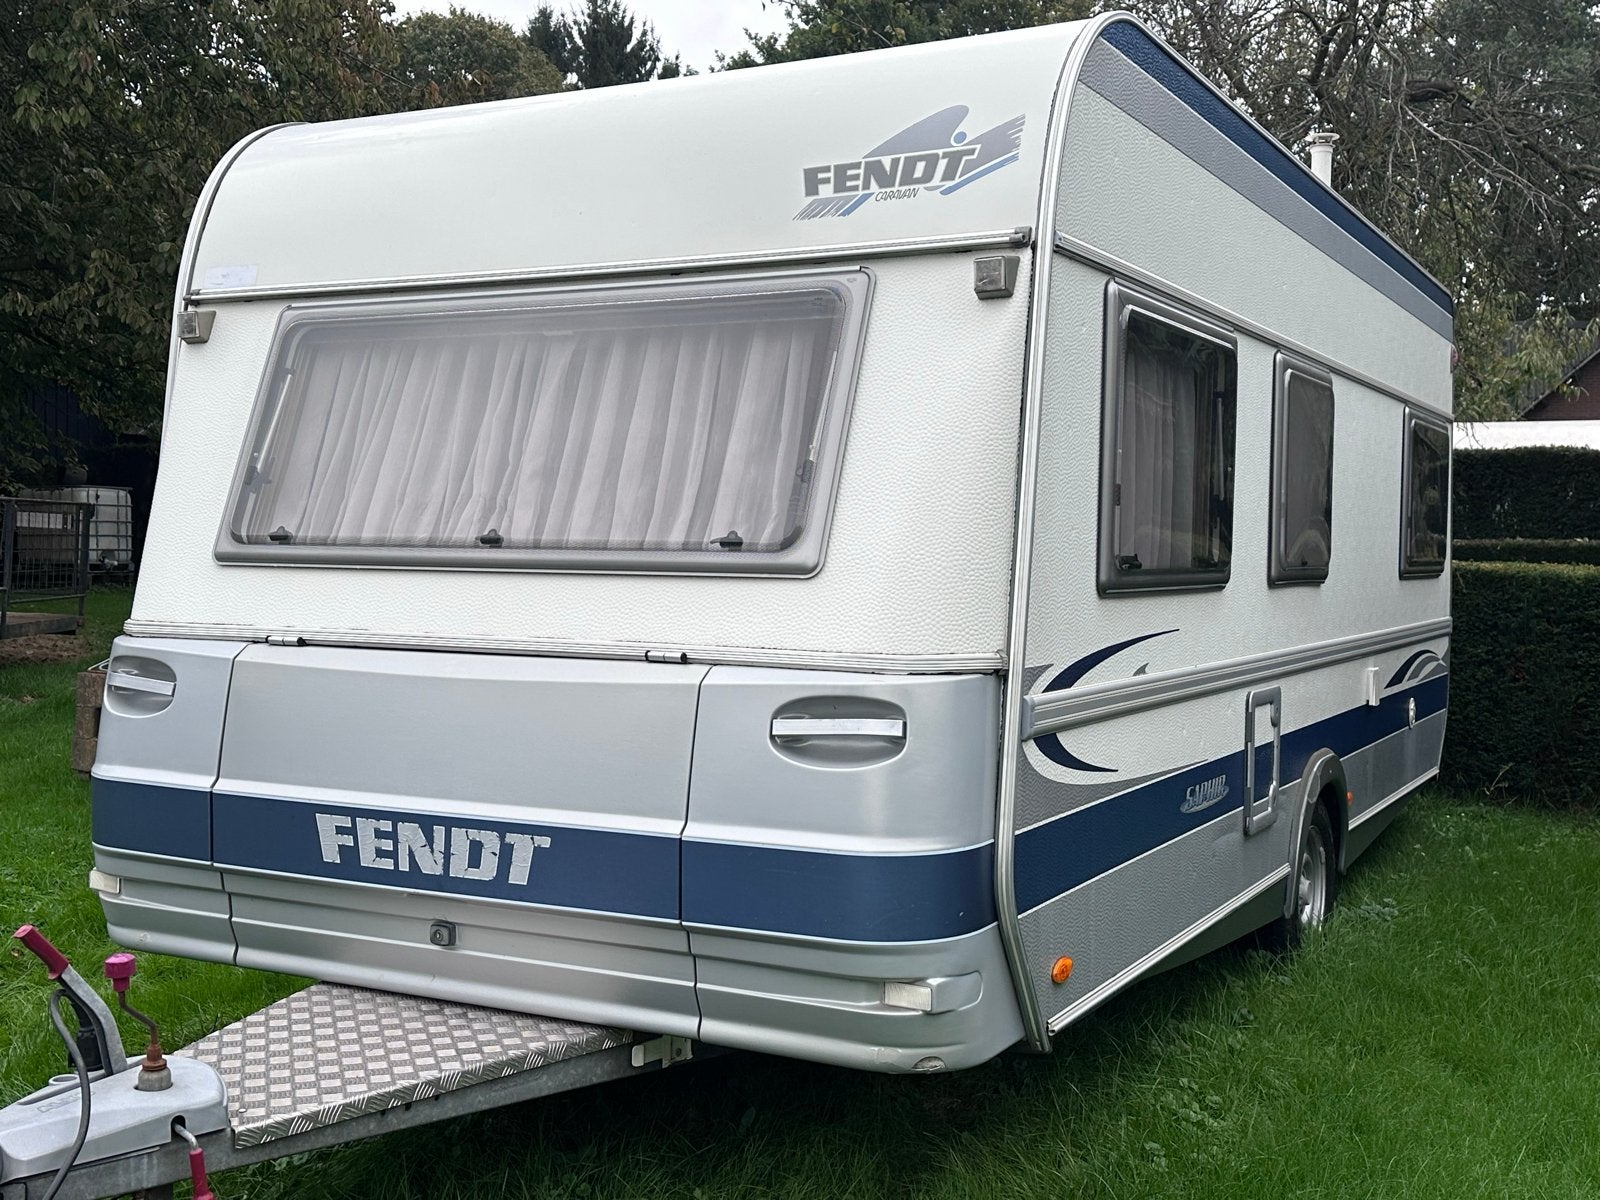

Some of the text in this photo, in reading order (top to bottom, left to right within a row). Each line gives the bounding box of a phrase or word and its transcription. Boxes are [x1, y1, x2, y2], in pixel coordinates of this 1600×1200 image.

[803, 147, 977, 197] FENDT
[875, 187, 919, 201] CARAVAN
[1185, 774, 1226, 808] SAPHIR
[315, 812, 551, 885] FENDT
